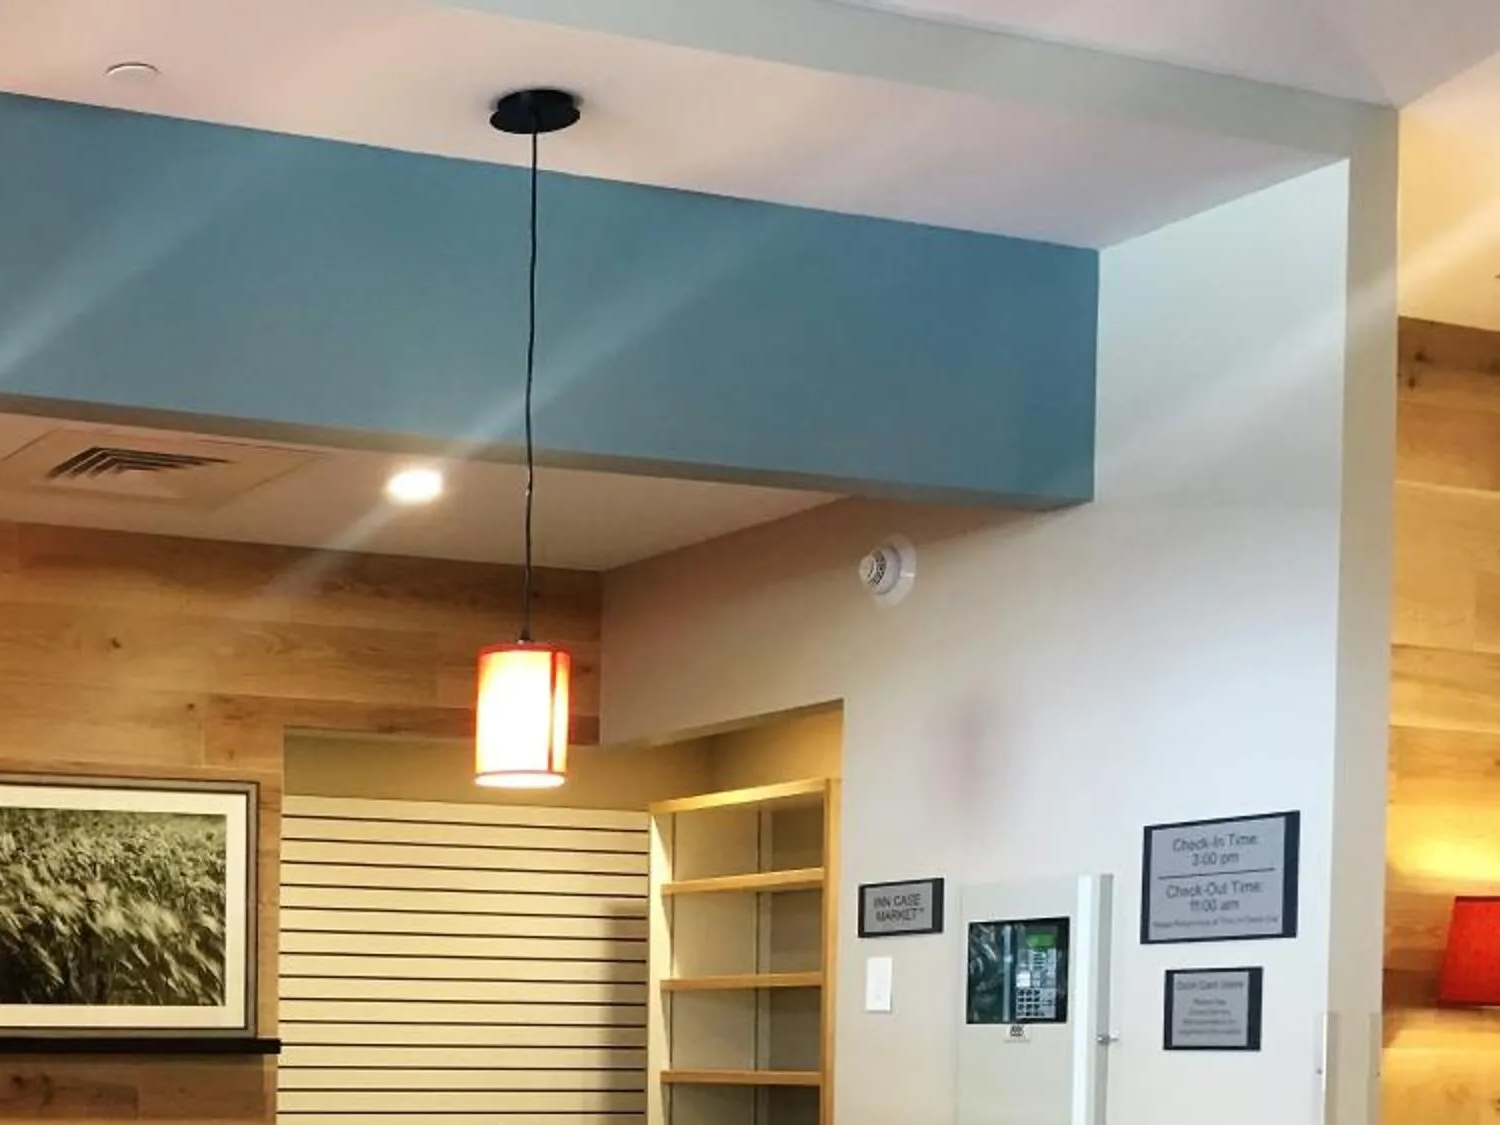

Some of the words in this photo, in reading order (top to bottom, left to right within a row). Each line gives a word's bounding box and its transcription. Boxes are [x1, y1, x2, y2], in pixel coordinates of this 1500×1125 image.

[1172, 835, 1226, 853] Check-In
[1191, 852, 1218, 867] 3:00
[1220, 852, 1240, 866] pm
[1165, 882, 1228, 899] Check-Out
[1189, 899, 1218, 912] 11:00
[1220, 900, 1240, 911] am
